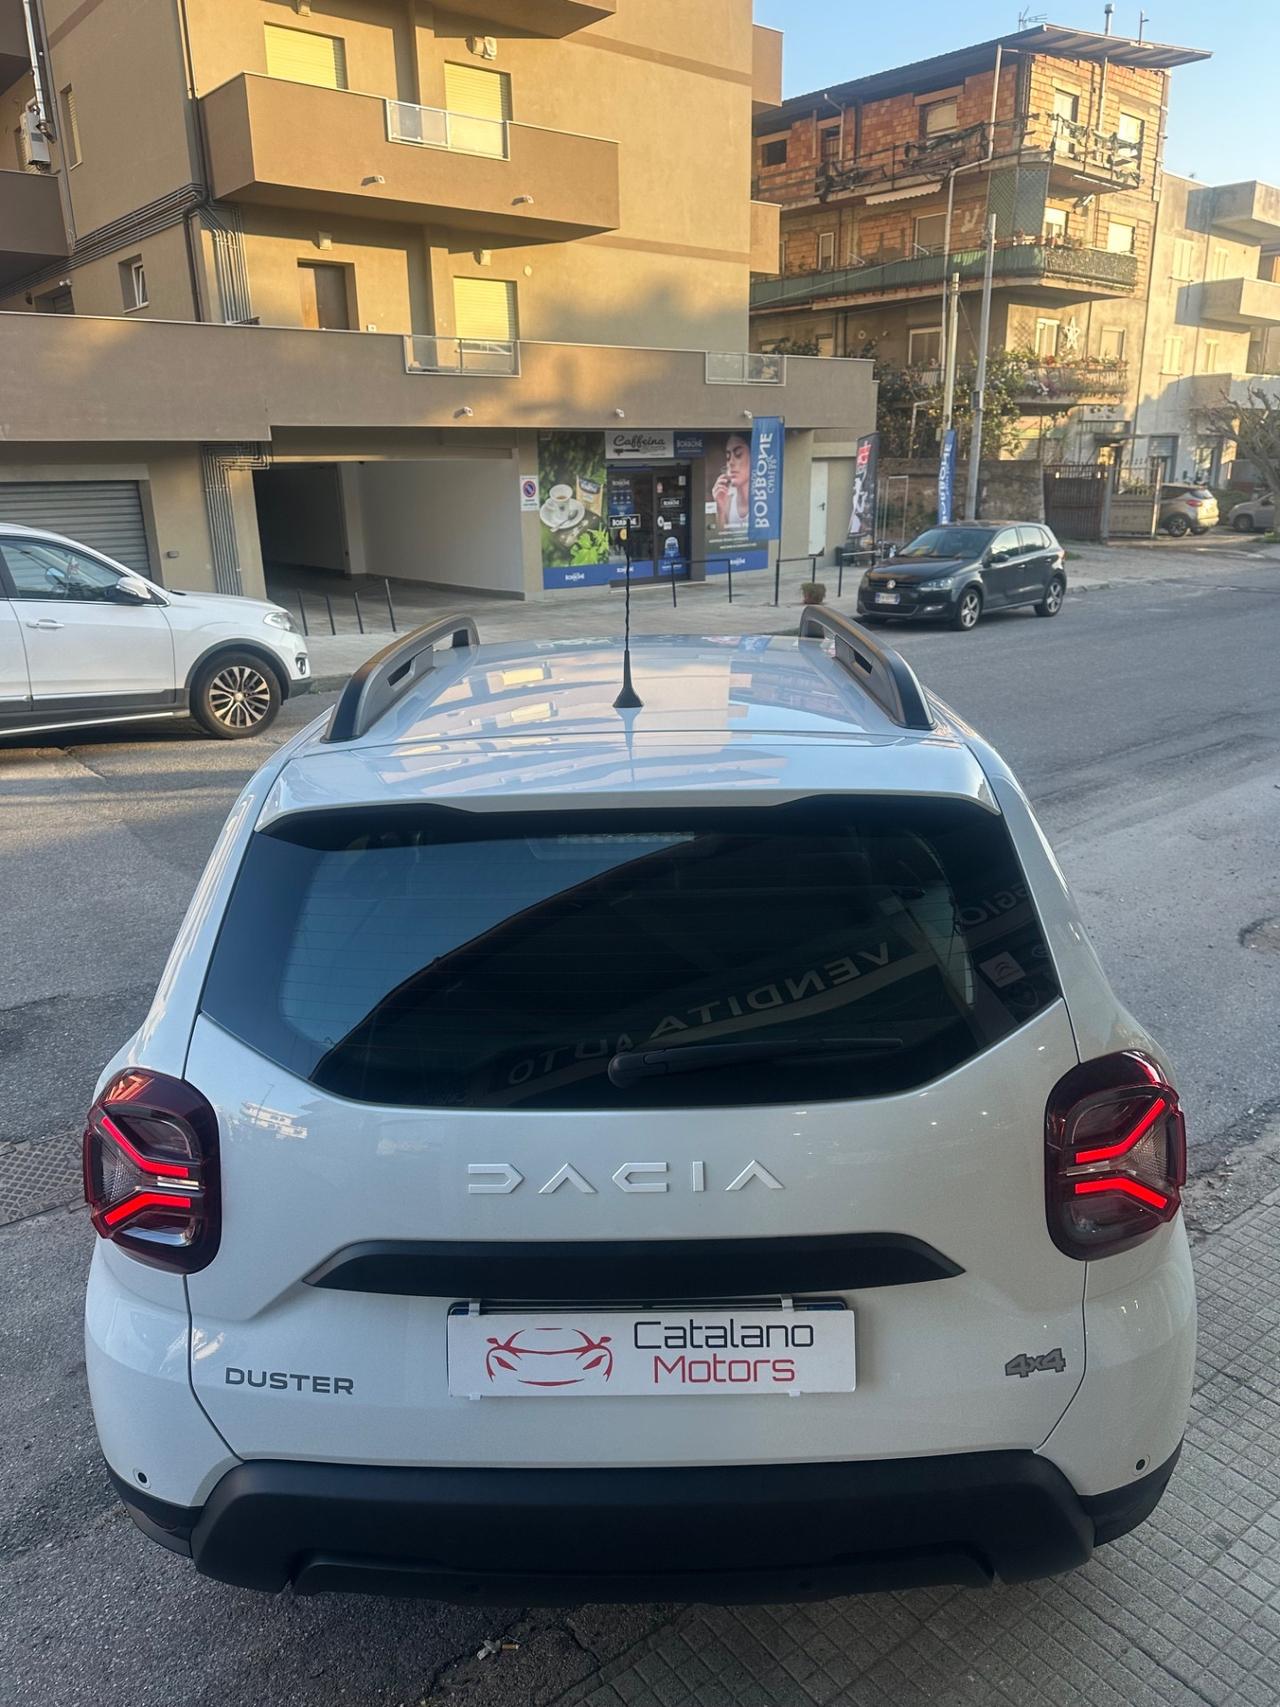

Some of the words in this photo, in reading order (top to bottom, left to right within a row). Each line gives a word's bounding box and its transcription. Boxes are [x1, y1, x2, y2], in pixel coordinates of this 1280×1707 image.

[613, 434, 665, 448] Caffeina
[467, 1159, 785, 1195] DACIA
[634, 1318, 814, 1350] Catalano
[654, 1353, 796, 1384] Motors
[1005, 1347, 1067, 1378] 4x4
[225, 1366, 354, 1395] DUSTER
